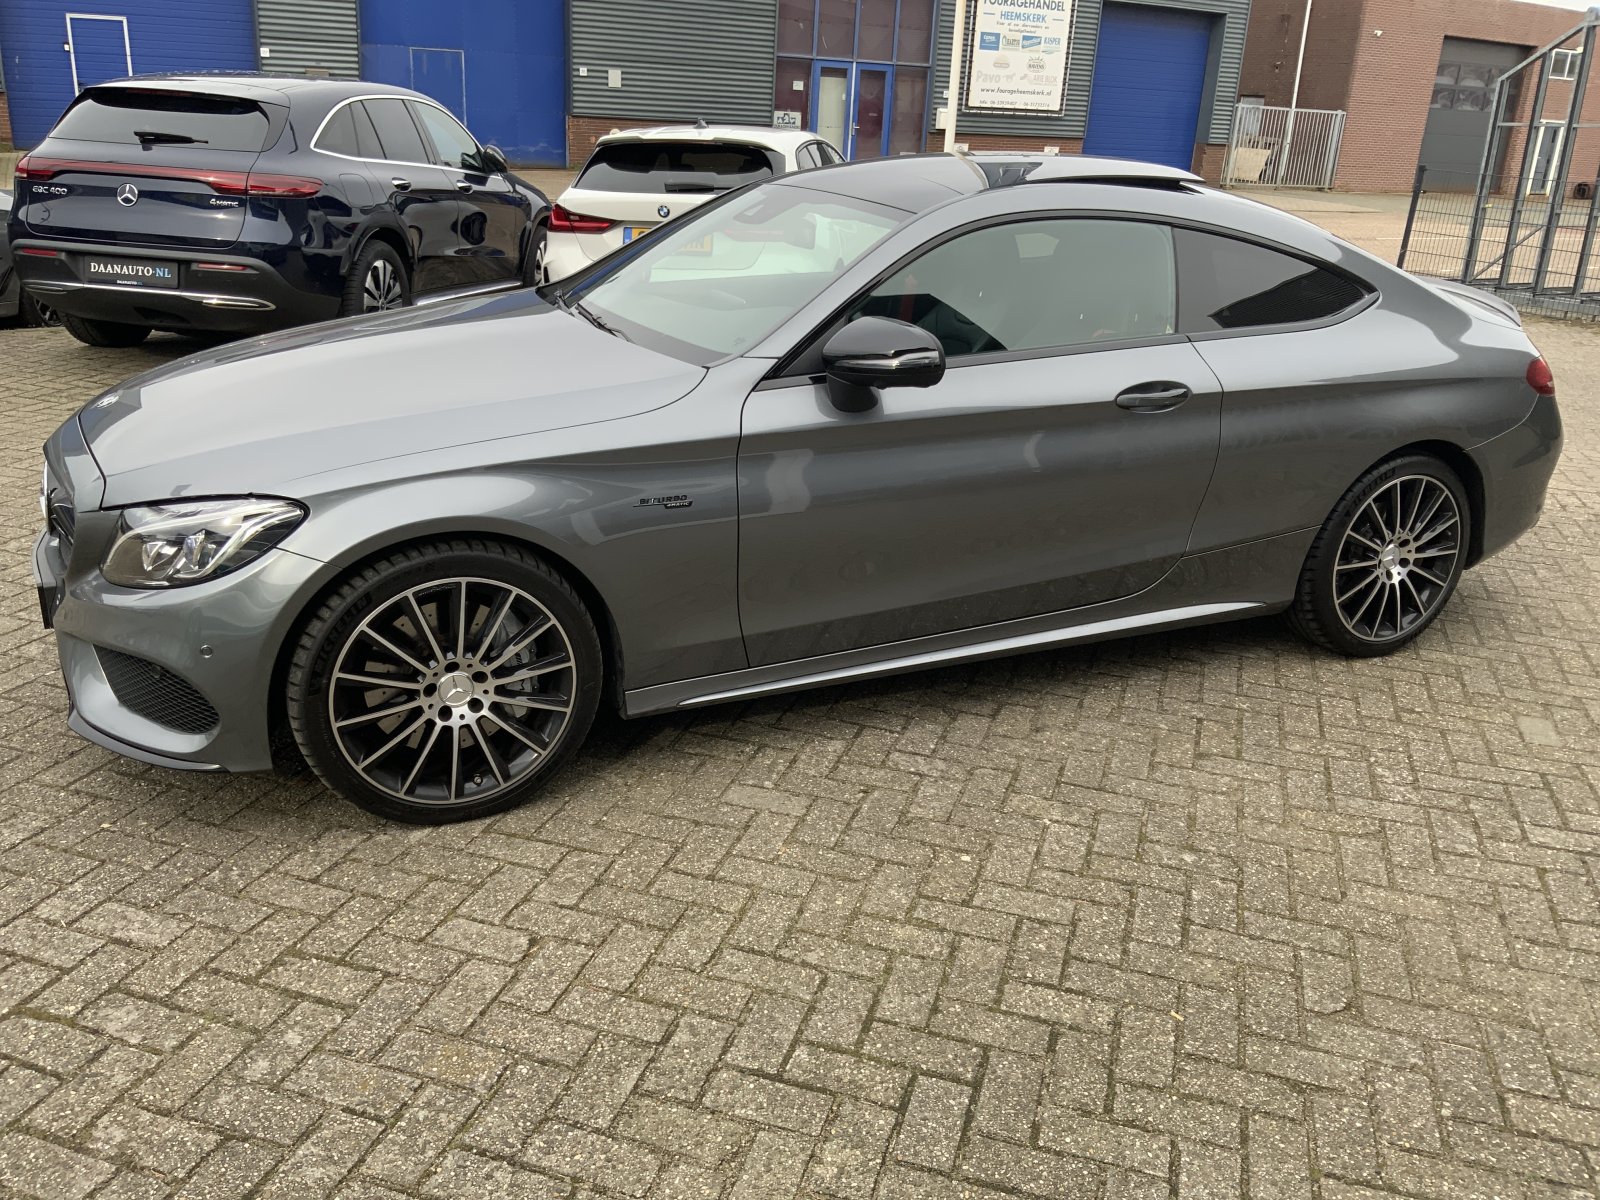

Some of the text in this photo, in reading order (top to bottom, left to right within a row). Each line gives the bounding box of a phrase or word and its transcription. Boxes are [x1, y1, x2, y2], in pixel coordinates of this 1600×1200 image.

[1000, 11, 1047, 23] HEEMSKERK
[976, 70, 1001, 83] Pavo
[32, 185, 68, 195] EQC 400
[209, 198, 239, 208] 4MATIC
